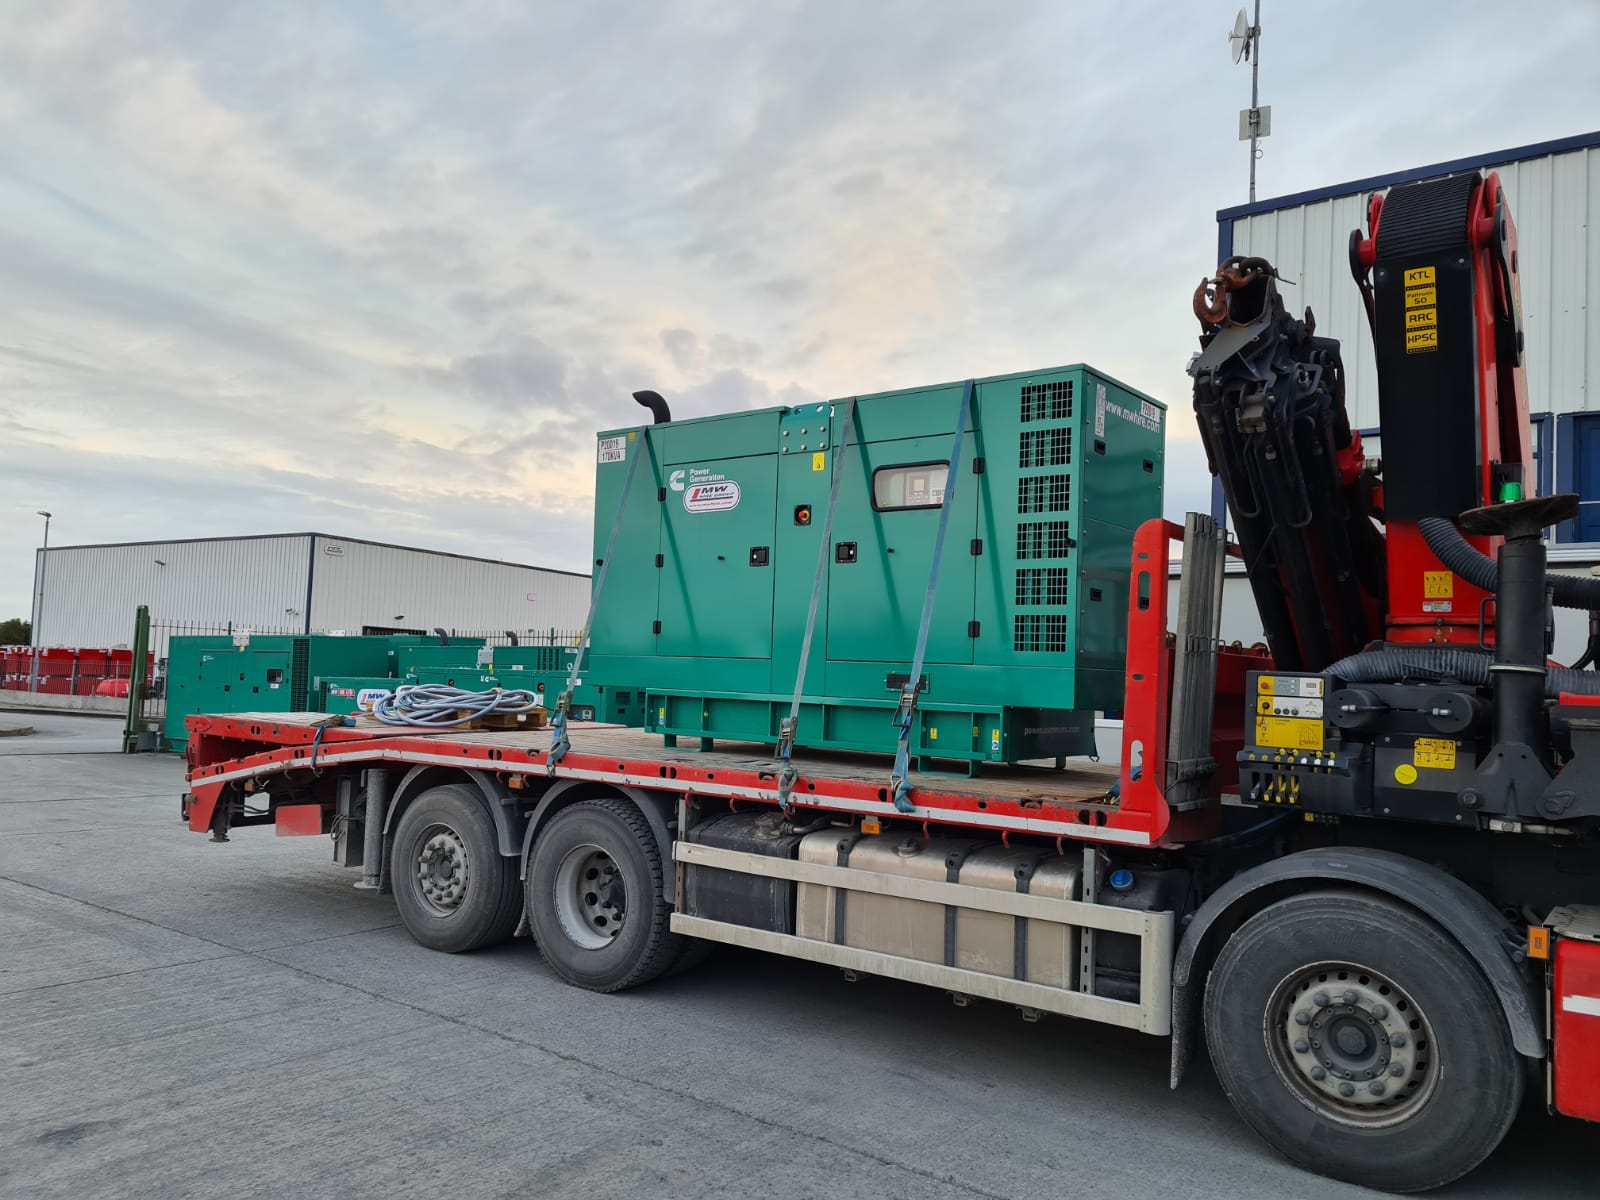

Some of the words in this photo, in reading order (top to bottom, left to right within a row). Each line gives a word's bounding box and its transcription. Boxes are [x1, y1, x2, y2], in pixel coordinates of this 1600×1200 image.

[1409, 271, 1430, 281] KTL
[1407, 332, 1436, 344] HPSC
[690, 474, 725, 482] Generation
[701, 485, 728, 494] MW
